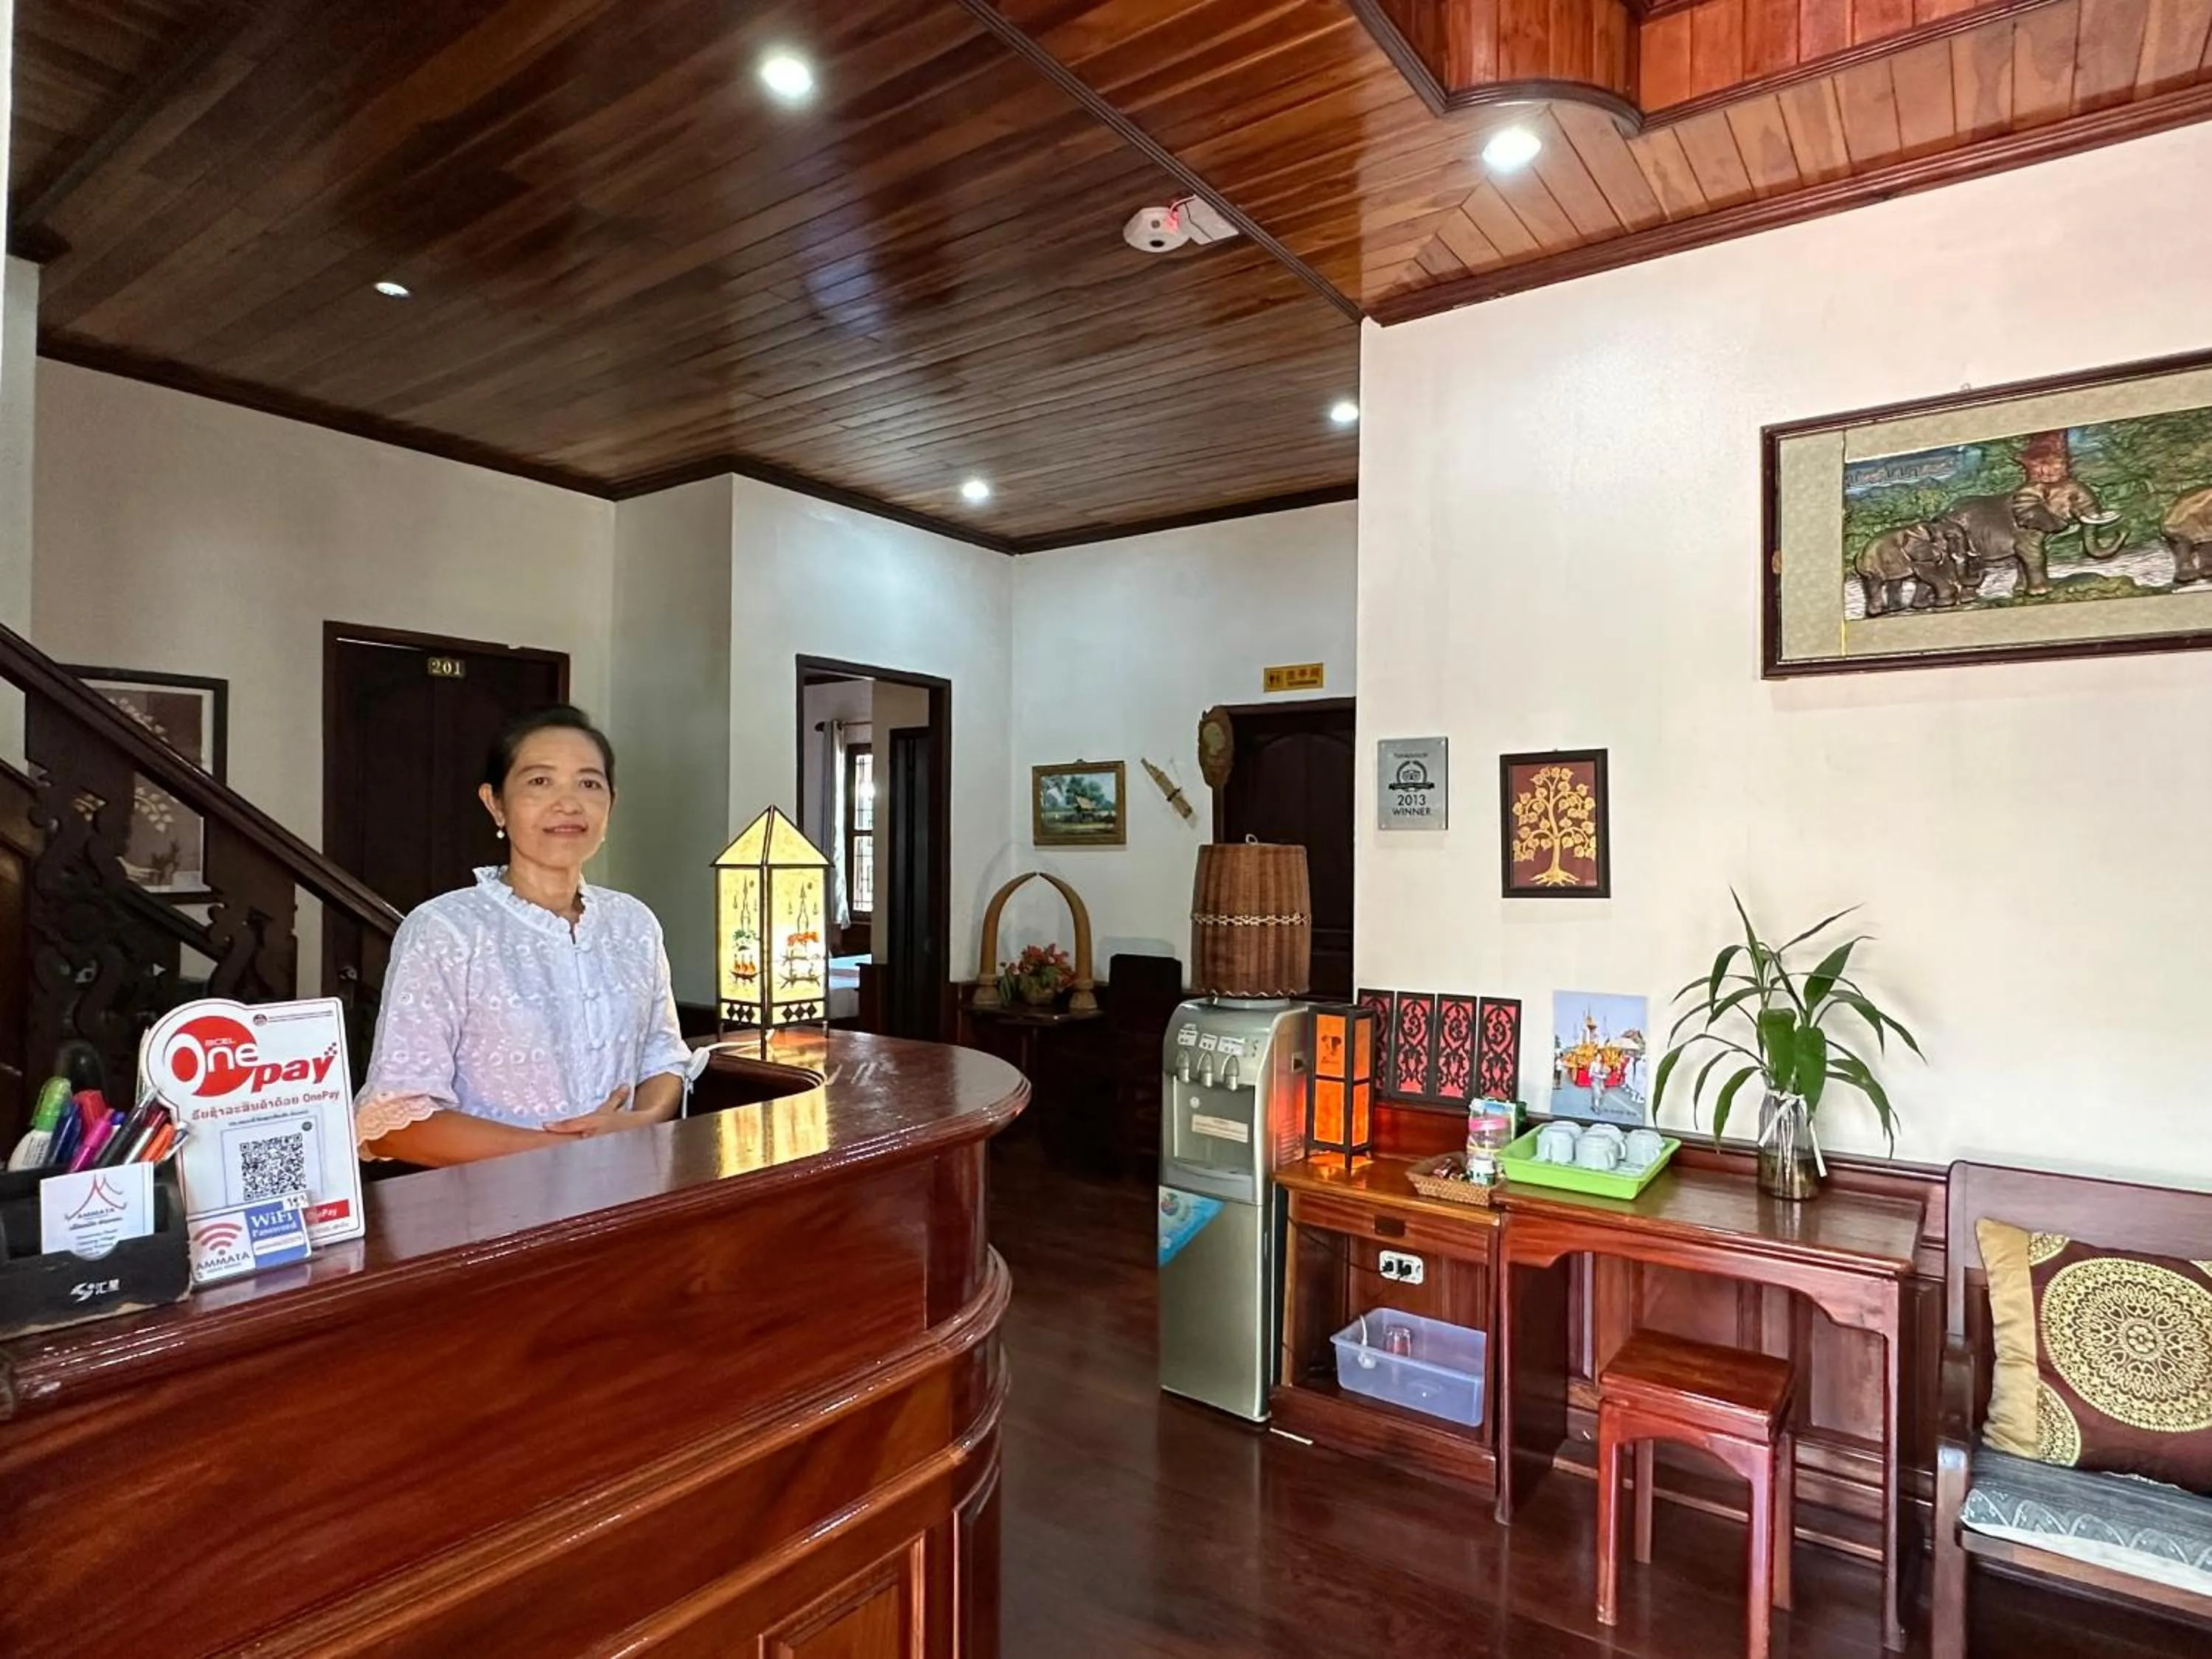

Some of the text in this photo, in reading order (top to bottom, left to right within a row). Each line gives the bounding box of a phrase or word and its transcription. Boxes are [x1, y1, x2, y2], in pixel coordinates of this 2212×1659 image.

[431, 660, 461, 675] 201
[1397, 794, 1426, 806] 2013
[1392, 807, 1430, 816] WINNER
[251, 1055, 335, 1093] pay
[303, 1091, 340, 1103] OnePay
[251, 1211, 293, 1228] WiFi
[195, 1251, 251, 1269] AMMATA
